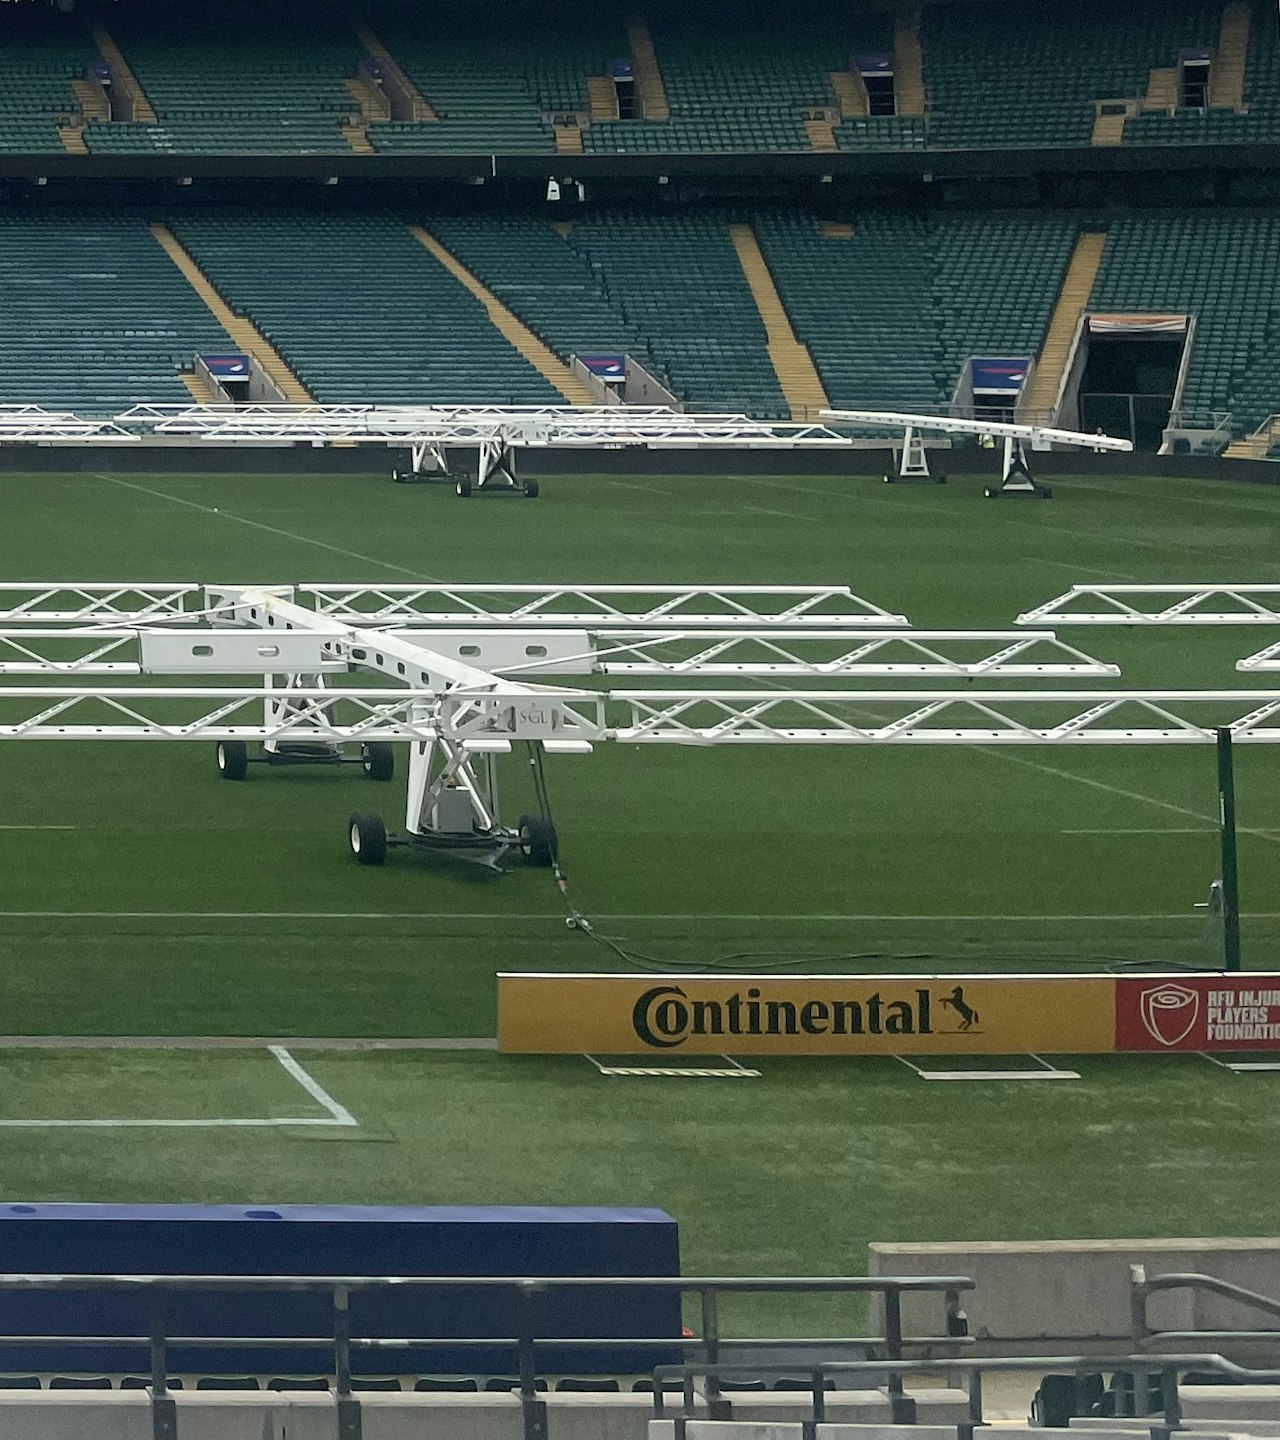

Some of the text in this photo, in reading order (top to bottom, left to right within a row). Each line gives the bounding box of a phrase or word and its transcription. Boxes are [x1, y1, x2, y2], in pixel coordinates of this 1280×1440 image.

[520, 709, 547, 724] SGL
[1208, 991, 1234, 1006] RFU
[632, 985, 934, 1048] Continental
[1208, 1007, 1268, 1023] PLAYERS
